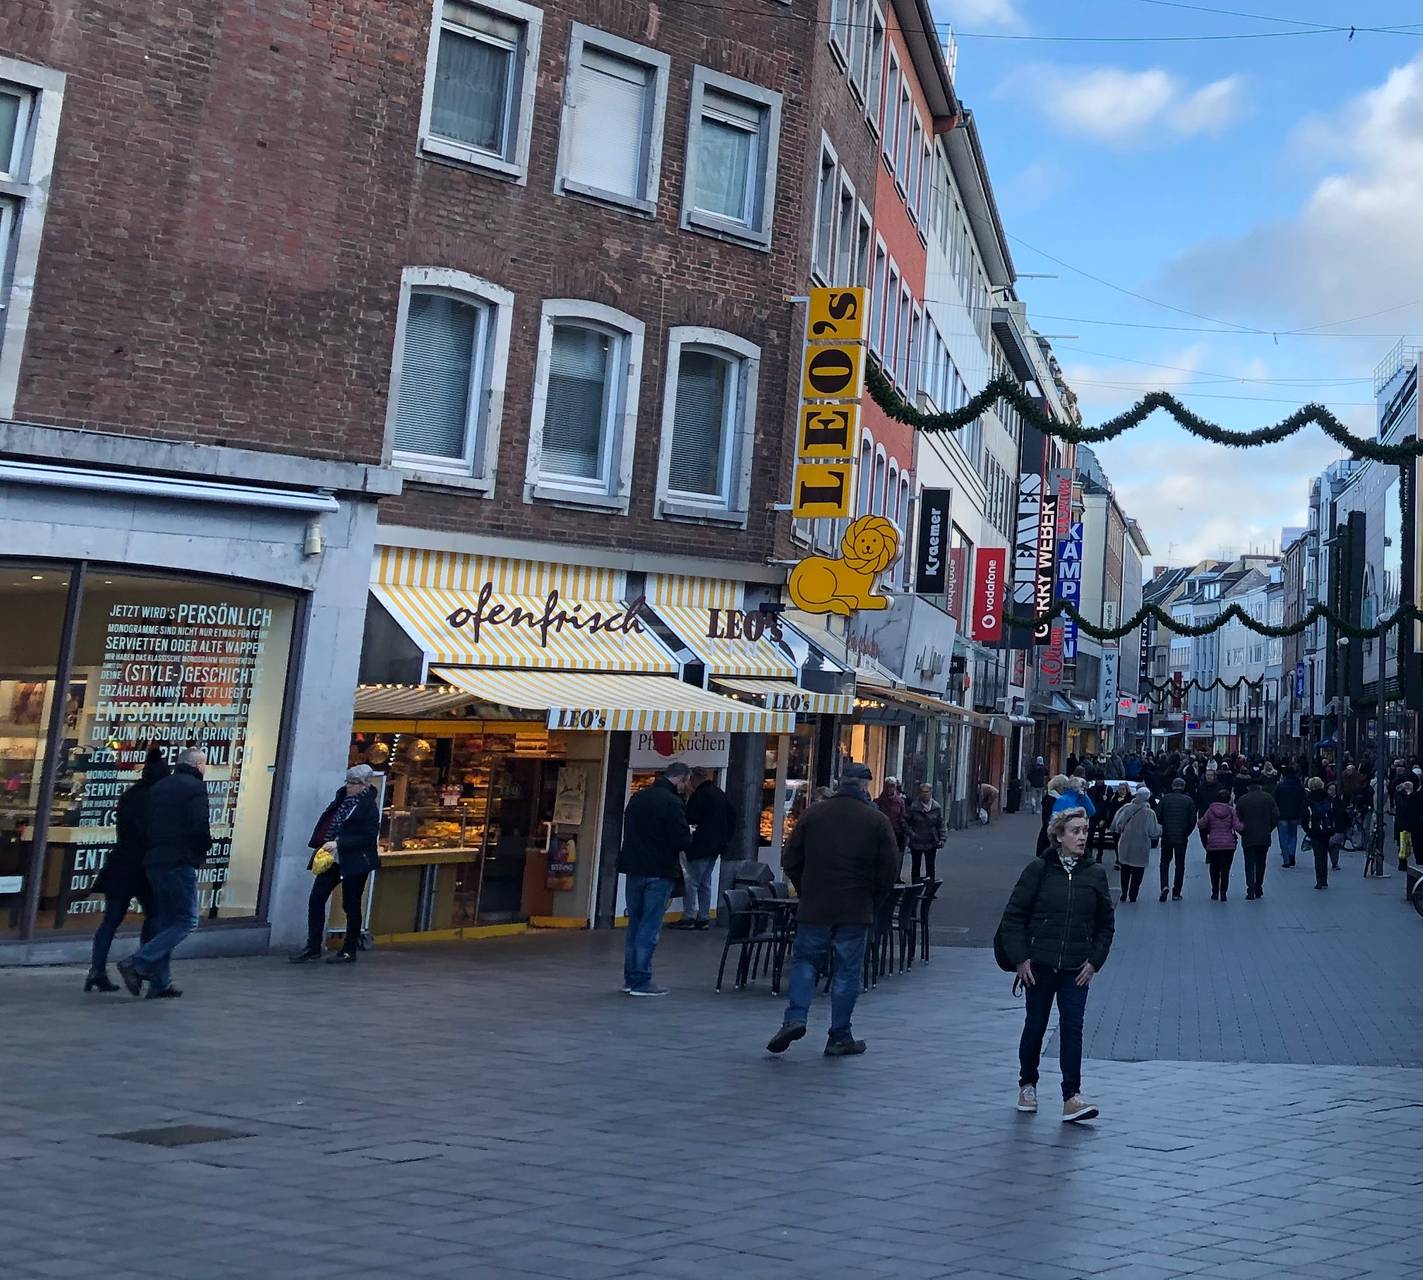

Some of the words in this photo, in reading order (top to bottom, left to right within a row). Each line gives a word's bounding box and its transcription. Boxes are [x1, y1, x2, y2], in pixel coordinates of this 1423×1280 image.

[800, 292, 857, 509] LEO's
[925, 507, 942, 576] Kraemer
[1038, 502, 1056, 568] WEBER
[985, 559, 997, 612] vodafone
[1060, 523, 1081, 658] KÄMPEN
[110, 604, 140, 618] JETZT
[141, 605, 175, 620] WIRD'S
[177, 602, 273, 628] PERSÖNLICH
[447, 581, 647, 648] ofenfrisch
[1034, 575, 1052, 638] GRRY
[105, 636, 168, 651] SERVIETTEN
[170, 639, 198, 652] ODER
[200, 640, 223, 653] ALTE
[99, 684, 149, 698] ERZÄHLEN
[190, 686, 218, 699] JETZT
[219, 687, 246, 699] LIEGT
[95, 701, 222, 722] ENTSCHEIDUNG
[557, 709, 606, 729] LEO's
[139, 726, 199, 741] AUSDRUCK
[638, 732, 725, 751] Pfnkuchen
[120, 750, 146, 763] WIRD
[67, 900, 97, 914] JETZT
